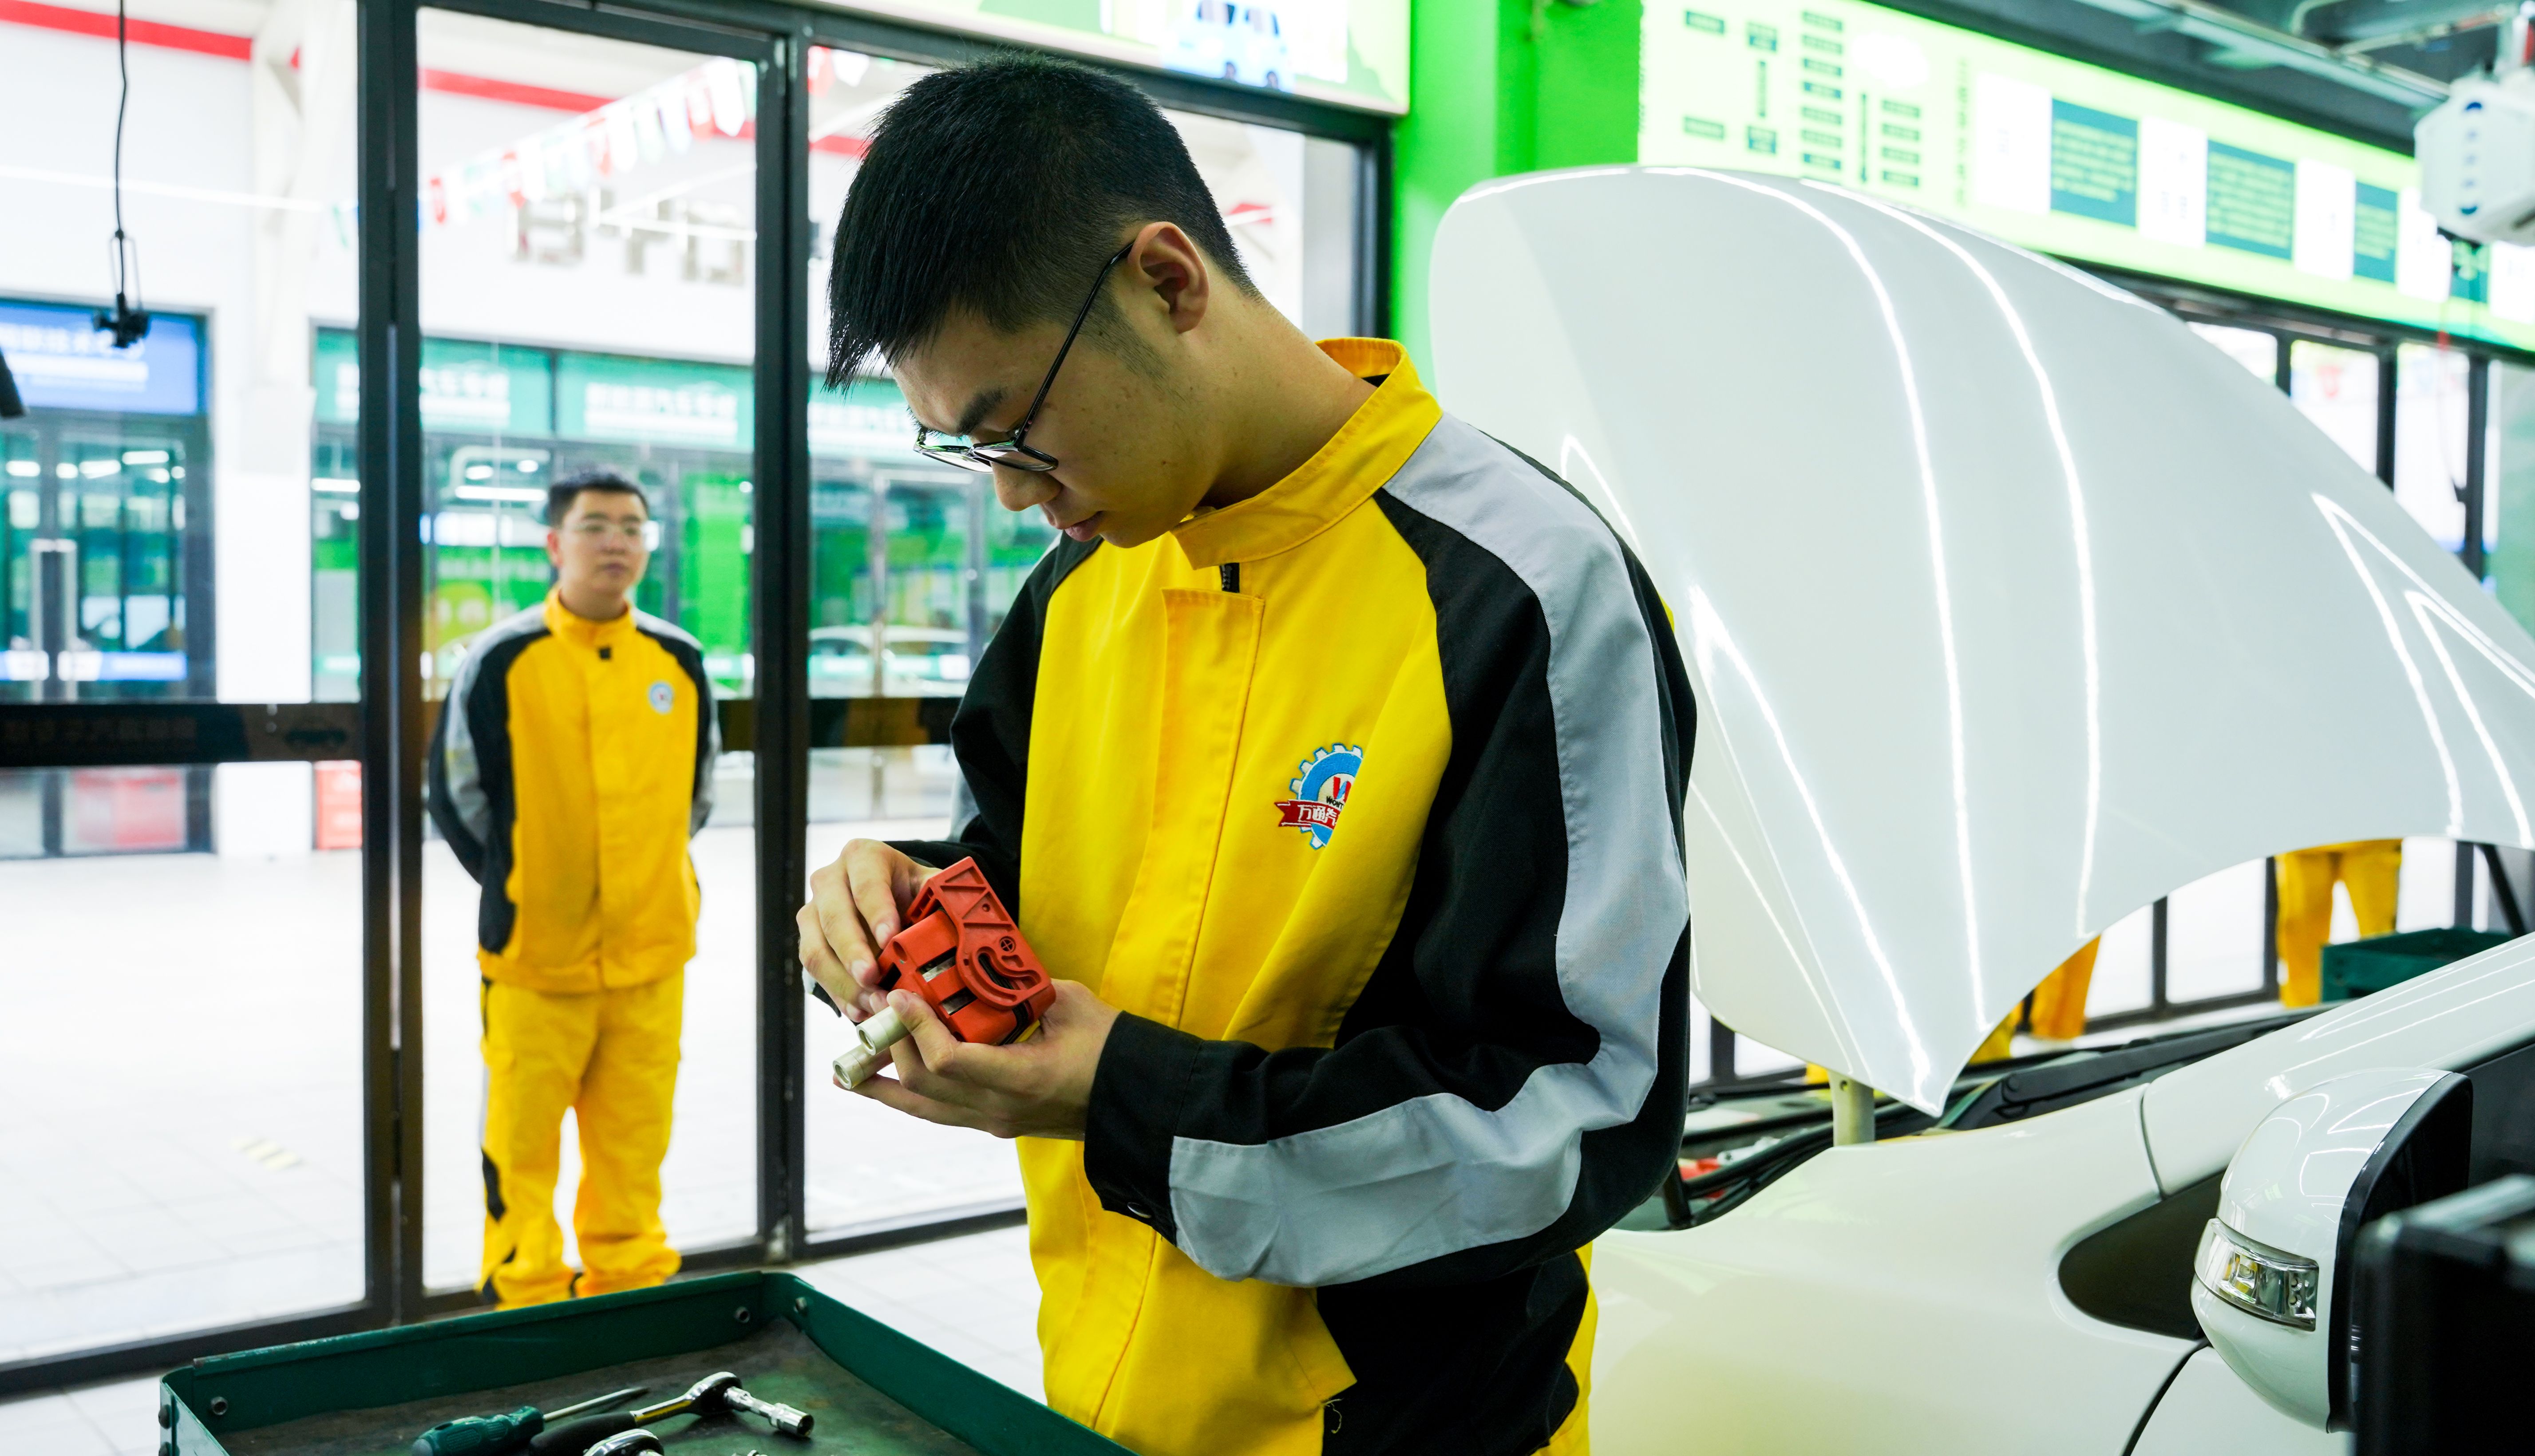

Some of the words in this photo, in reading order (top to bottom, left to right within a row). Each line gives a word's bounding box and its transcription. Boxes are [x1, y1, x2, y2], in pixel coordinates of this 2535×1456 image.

[1326, 796, 1344, 809] WONT
[1297, 804, 1337, 826] 万通汽
